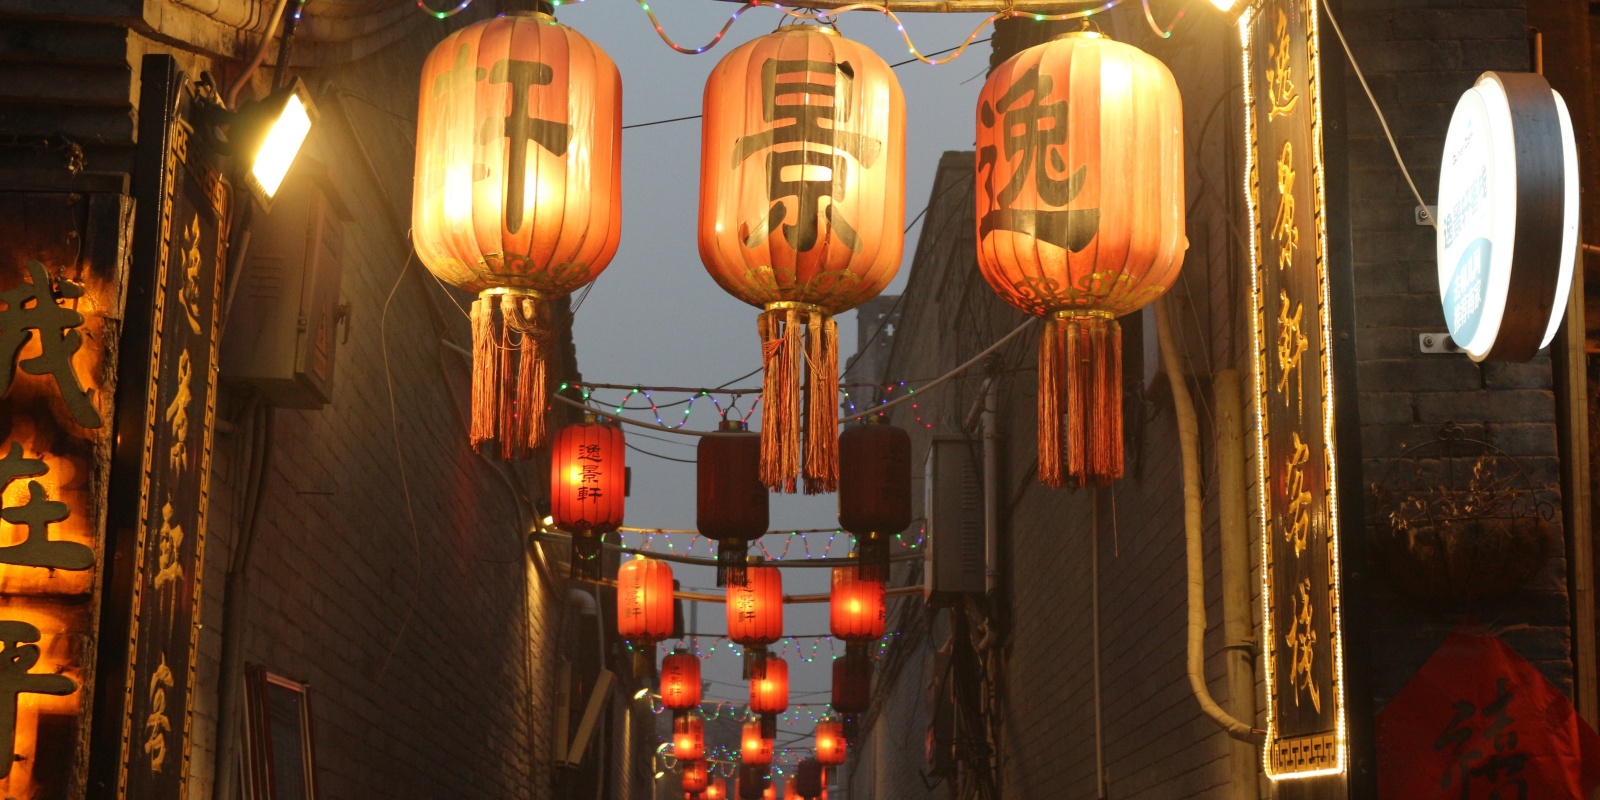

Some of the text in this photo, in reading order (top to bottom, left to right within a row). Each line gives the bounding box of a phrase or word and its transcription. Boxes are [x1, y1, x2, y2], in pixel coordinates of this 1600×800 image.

[732, 57, 882, 254] 景
[977, 65, 1101, 253] 逸
[577, 444, 603, 504] 逸景軒
